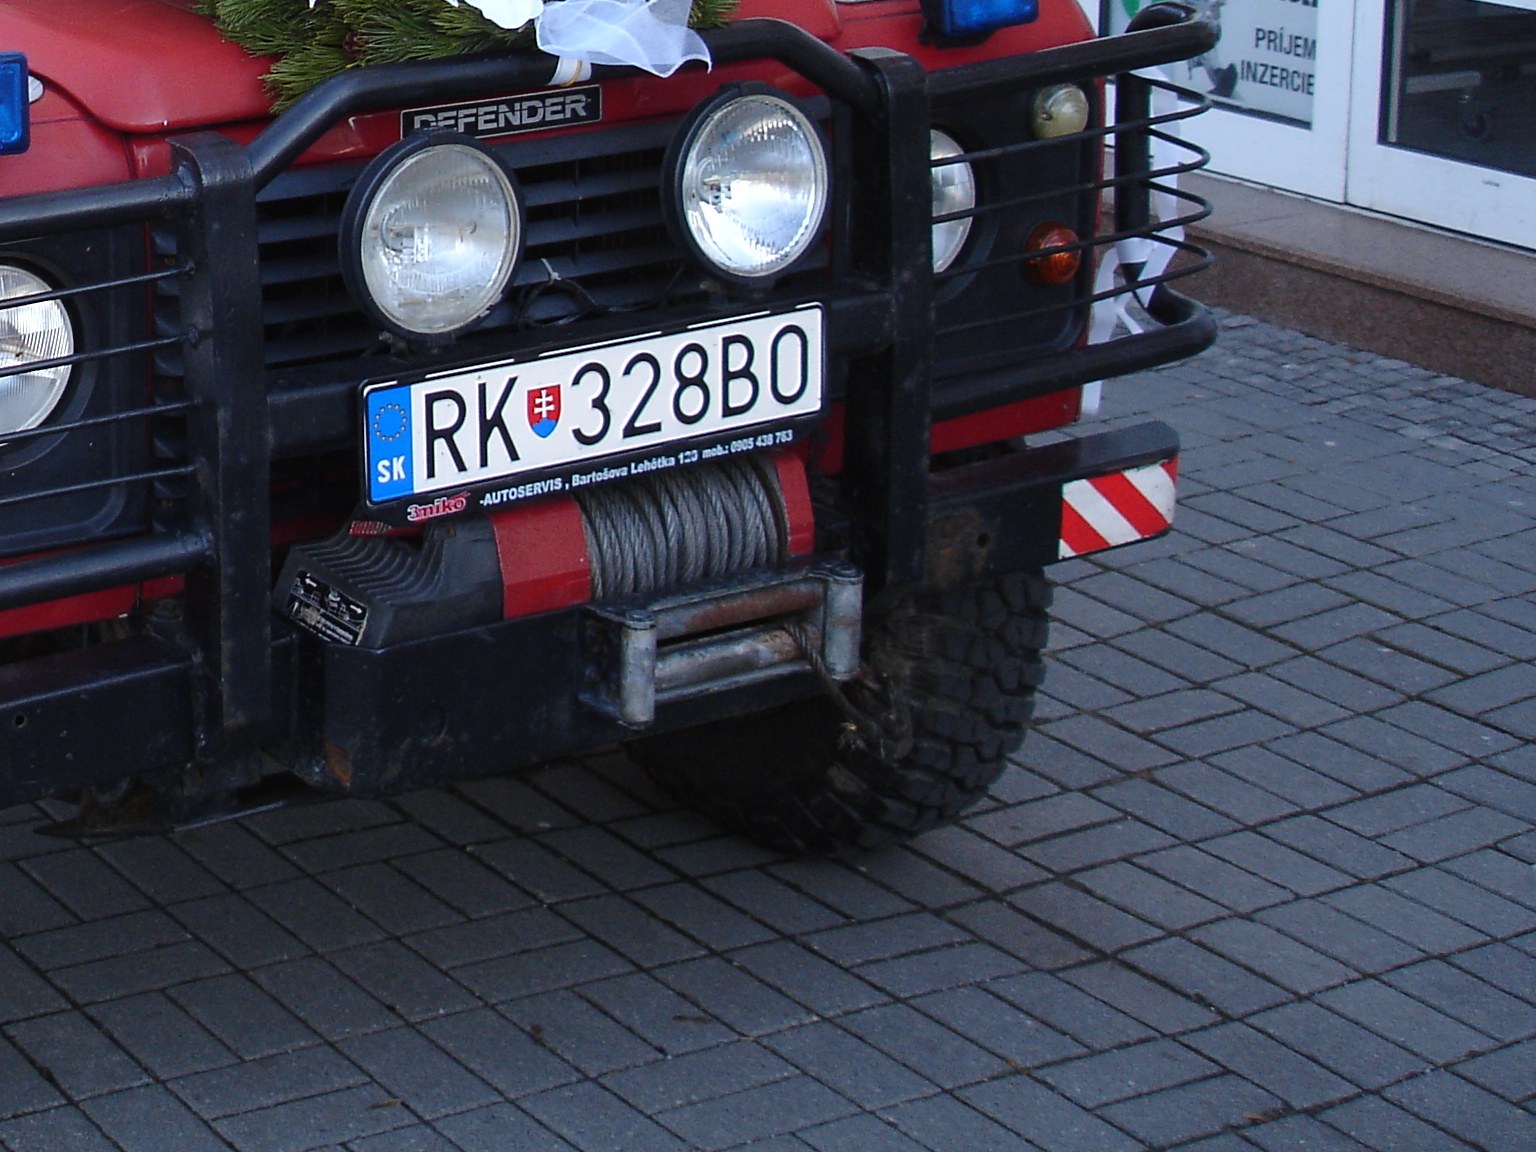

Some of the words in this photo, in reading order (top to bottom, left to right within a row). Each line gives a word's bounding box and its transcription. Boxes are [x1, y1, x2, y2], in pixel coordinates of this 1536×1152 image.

[1255, 27, 1316, 60] PRÍJEM
[1240, 59, 1314, 96] INZERCIE
[414, 94, 588, 133] DEFENDER
[424, 375, 521, 480] RK
[376, 455, 406, 483] SK
[572, 465, 628, 488] Bartošova
